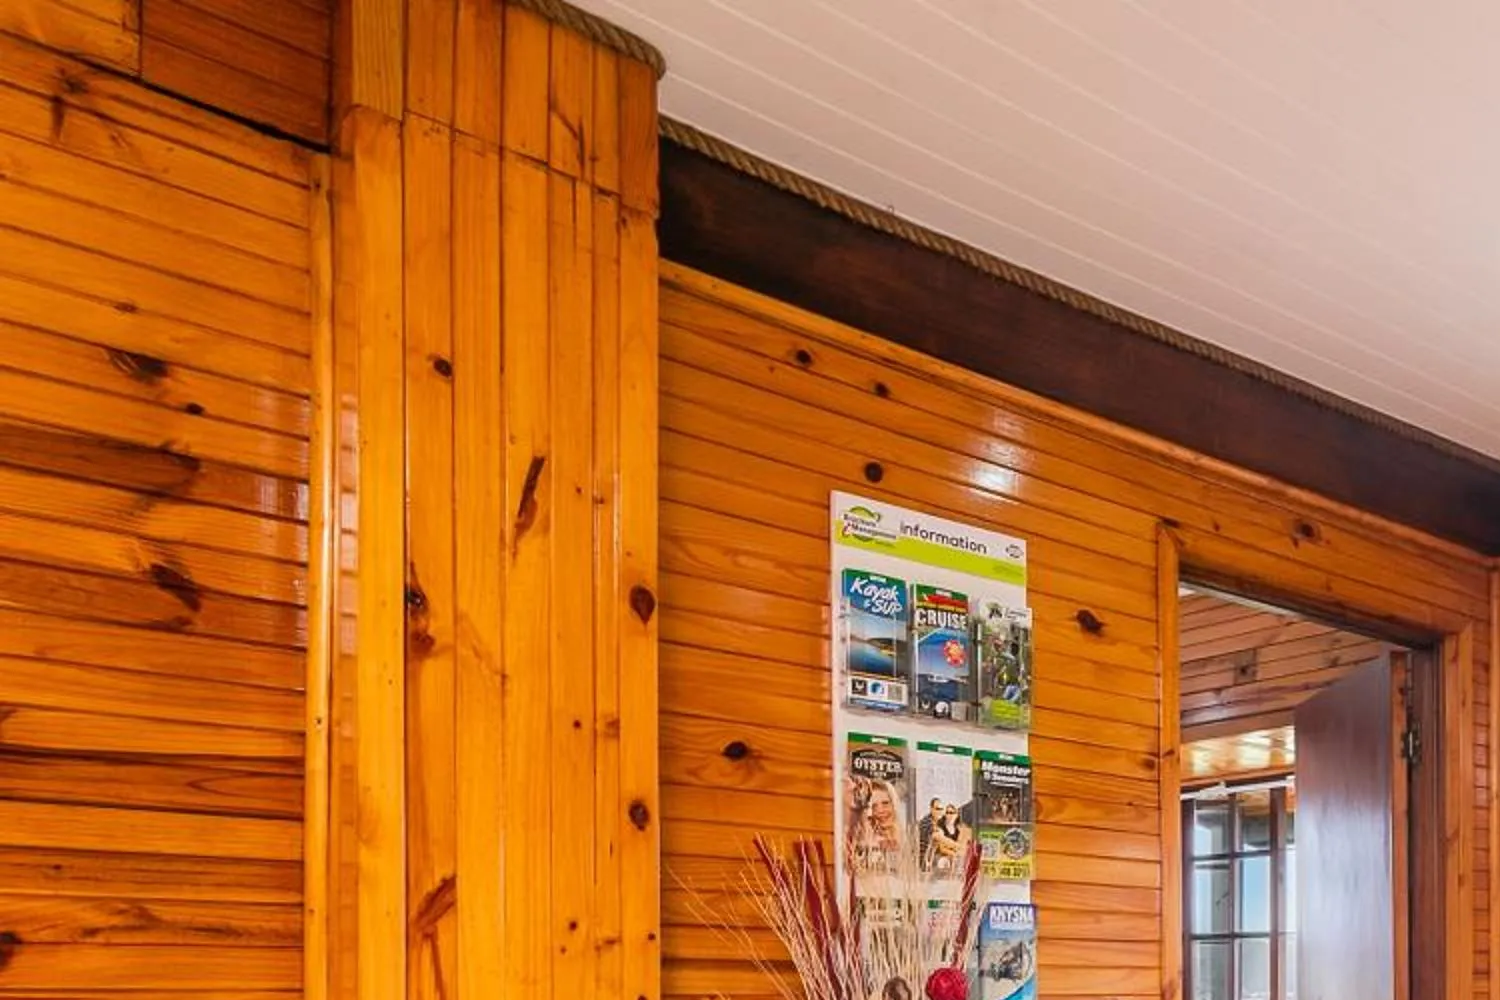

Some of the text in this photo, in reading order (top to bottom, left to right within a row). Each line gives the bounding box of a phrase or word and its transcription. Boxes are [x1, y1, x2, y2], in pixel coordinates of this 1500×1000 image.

[900, 520, 988, 555] information
[850, 577, 899, 602] Kayak
[872, 599, 903, 615] SUP
[915, 608, 968, 629] CRUISE
